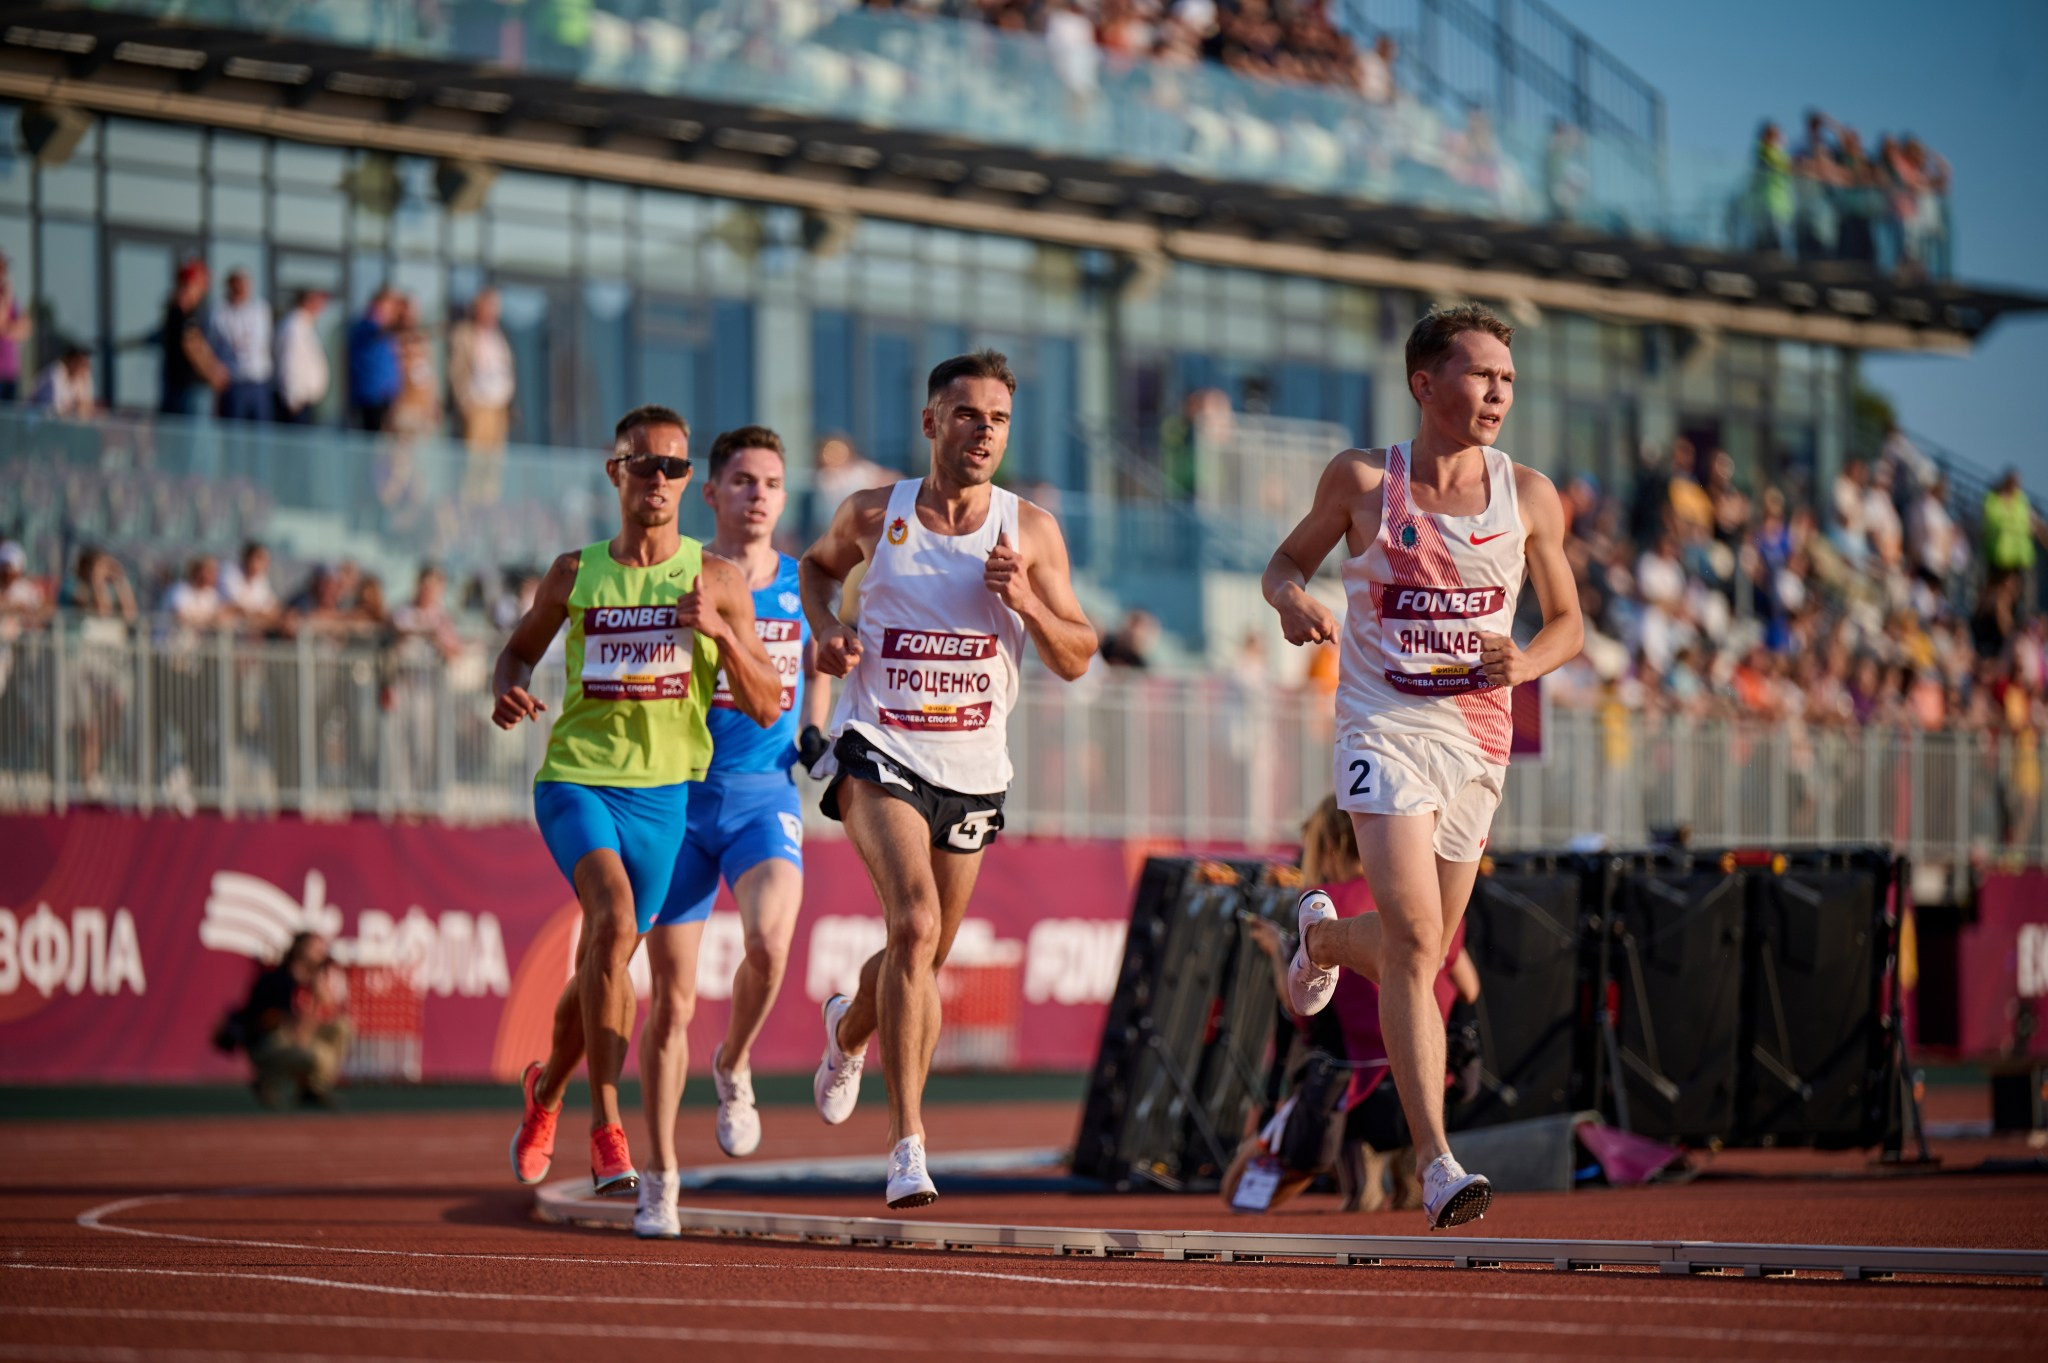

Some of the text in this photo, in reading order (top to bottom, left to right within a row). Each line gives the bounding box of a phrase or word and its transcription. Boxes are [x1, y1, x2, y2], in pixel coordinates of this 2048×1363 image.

[1396, 590, 1496, 613] FONBET
[594, 607, 677, 628] FONBET
[755, 620, 794, 640] BET
[600, 634, 675, 664] ГУРЖИЙ
[895, 633, 990, 657] FONBET
[1400, 629, 1484, 655] ЯНШАЕ
[886, 667, 991, 698] ТРОЦЕНКО
[1391, 674, 1470, 687] КОРОЛЕВА СПОРТА
[885, 711, 958, 723] КОРОЛЕВА СПОРТА
[1349, 759, 1370, 796] 2
[958, 822, 977, 840] 4
